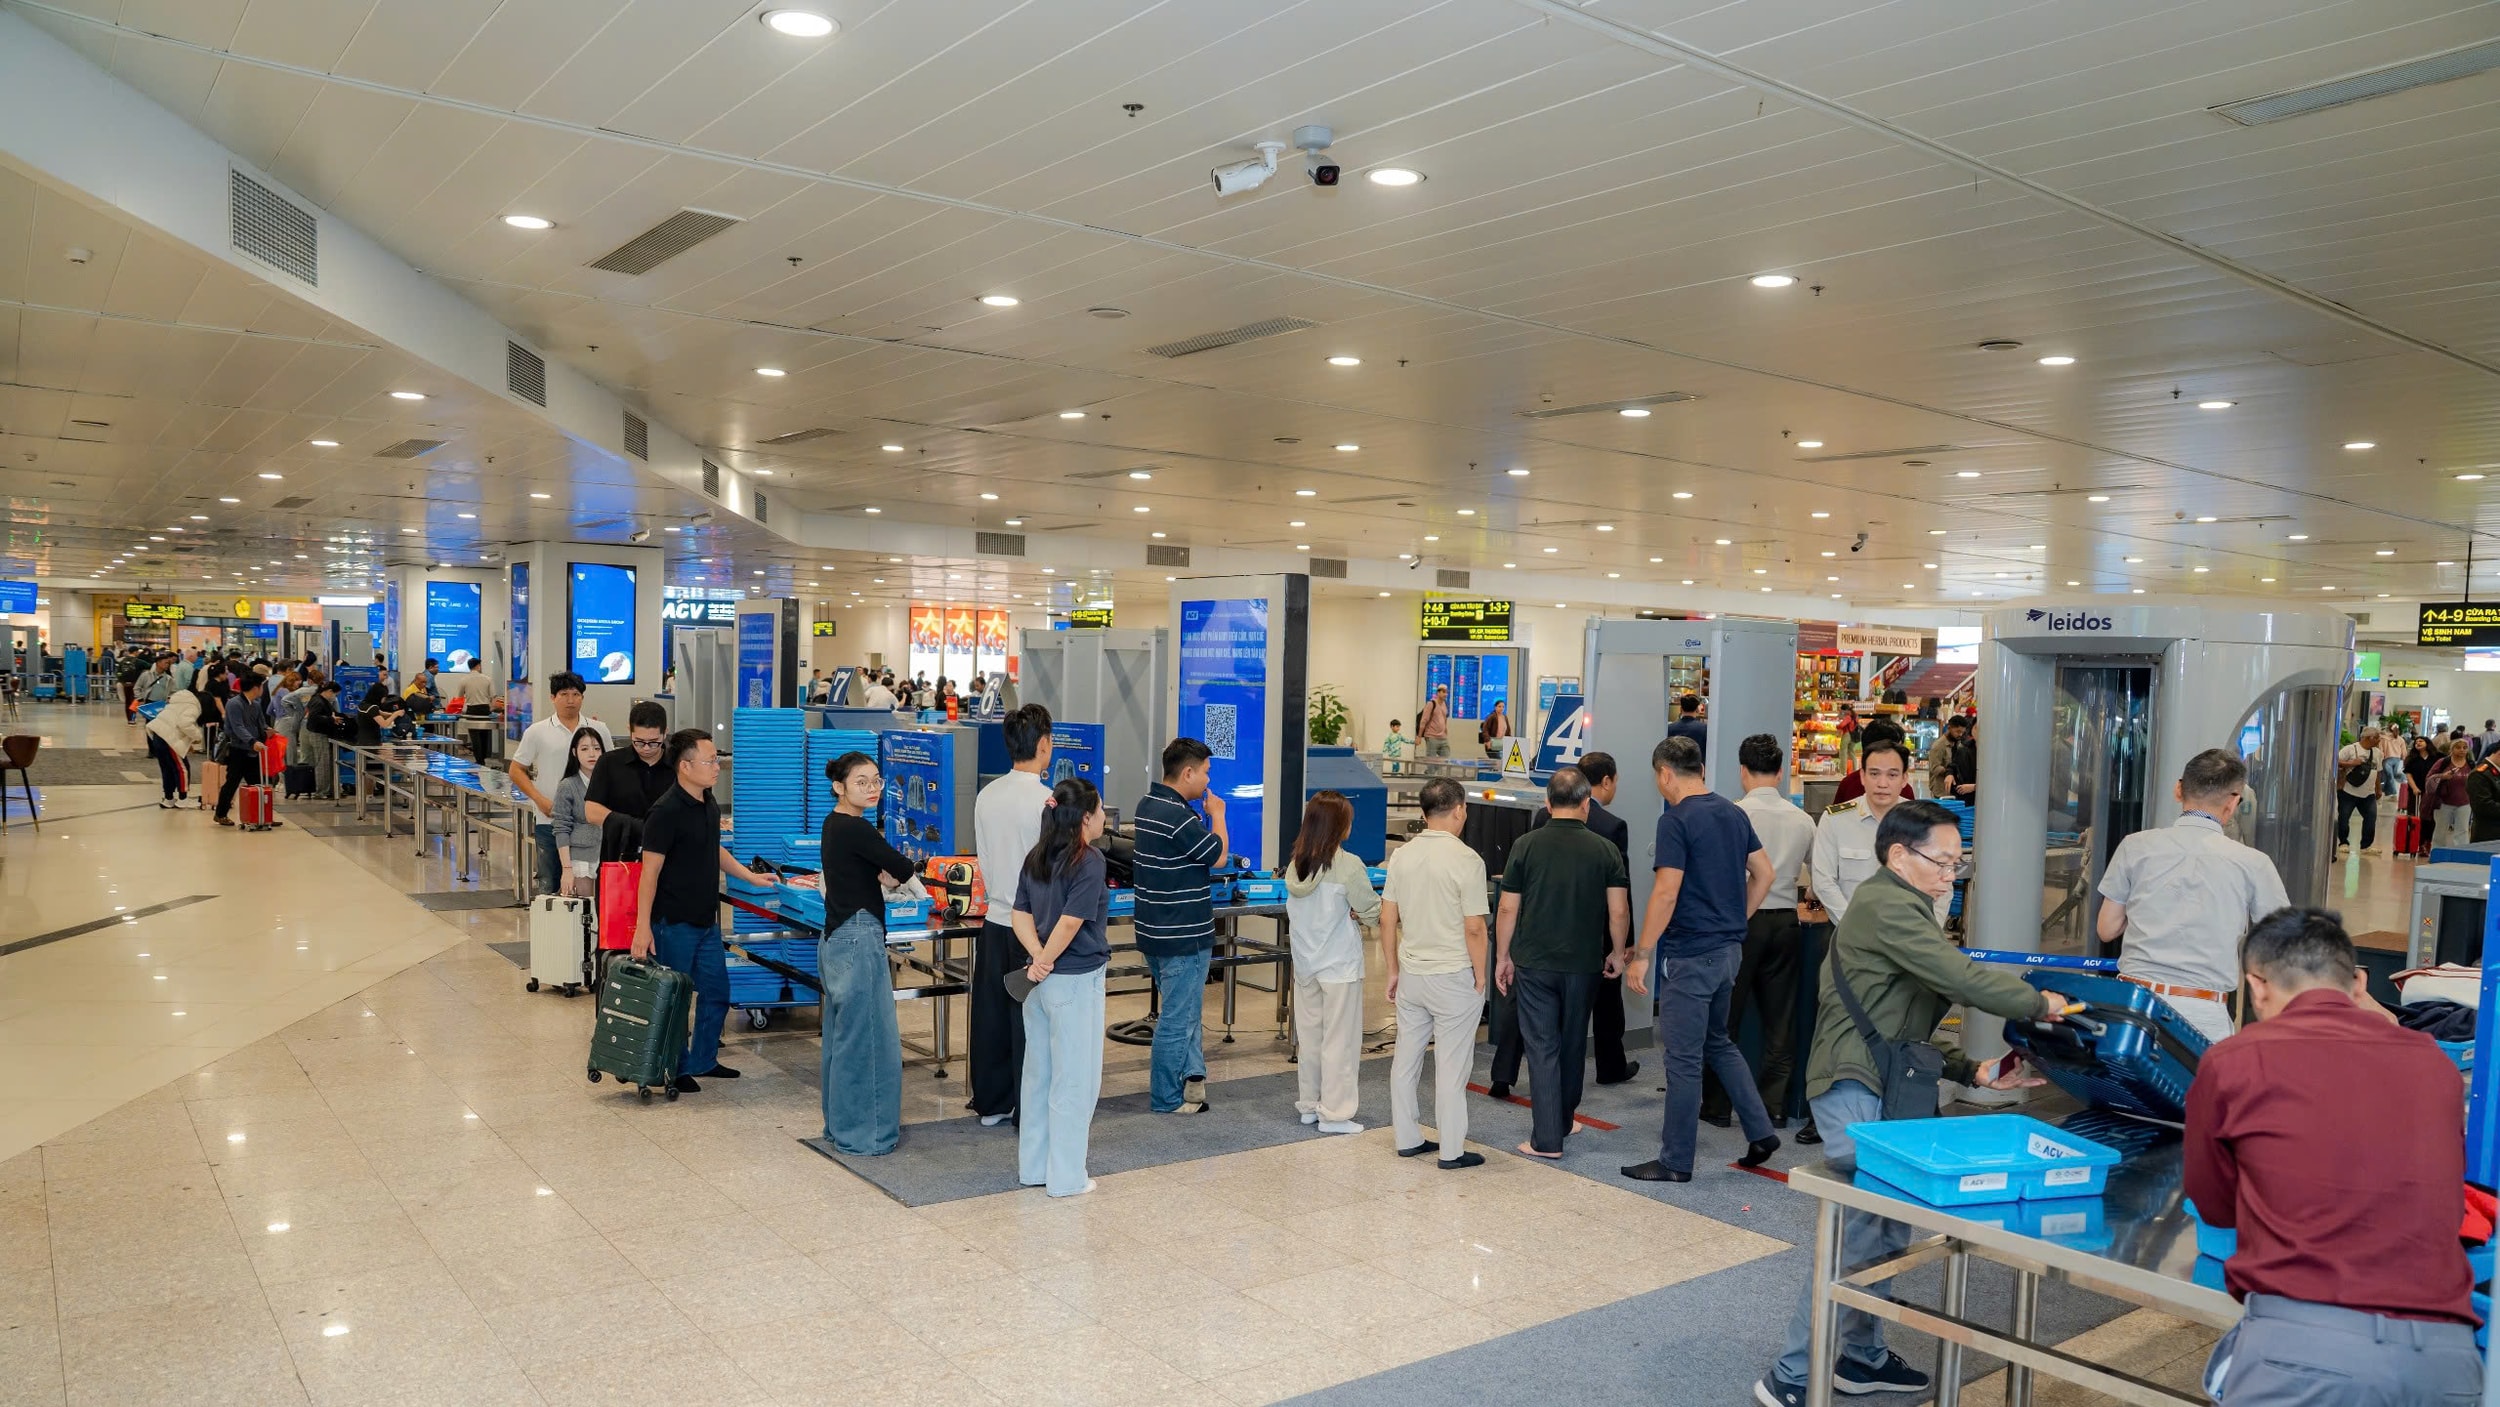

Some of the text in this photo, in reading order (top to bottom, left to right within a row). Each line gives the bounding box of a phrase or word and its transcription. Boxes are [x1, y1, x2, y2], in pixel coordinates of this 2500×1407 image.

[662, 602, 704, 619] ACV
[1432, 603, 1444, 612] 4-9
[1490, 602, 1502, 612] 1-3
[2466, 608, 2484, 616] CỬA
[1430, 616, 1450, 626] 10-17
[2048, 612, 2112, 630] leidos
[2438, 609, 2464, 622] 4-9
[2422, 628, 2433, 636] VỆ
[1841, 633, 1866, 645] PREMIUM
[1868, 635, 1888, 646] HERBAL
[1889, 636, 1918, 648] PRODUCTS
[834, 672, 850, 702] 7
[981, 678, 1000, 715] 6
[1546, 705, 1584, 764] 4
[2026, 956, 2044, 964] ACV
[2042, 1146, 2064, 1158] ACV
